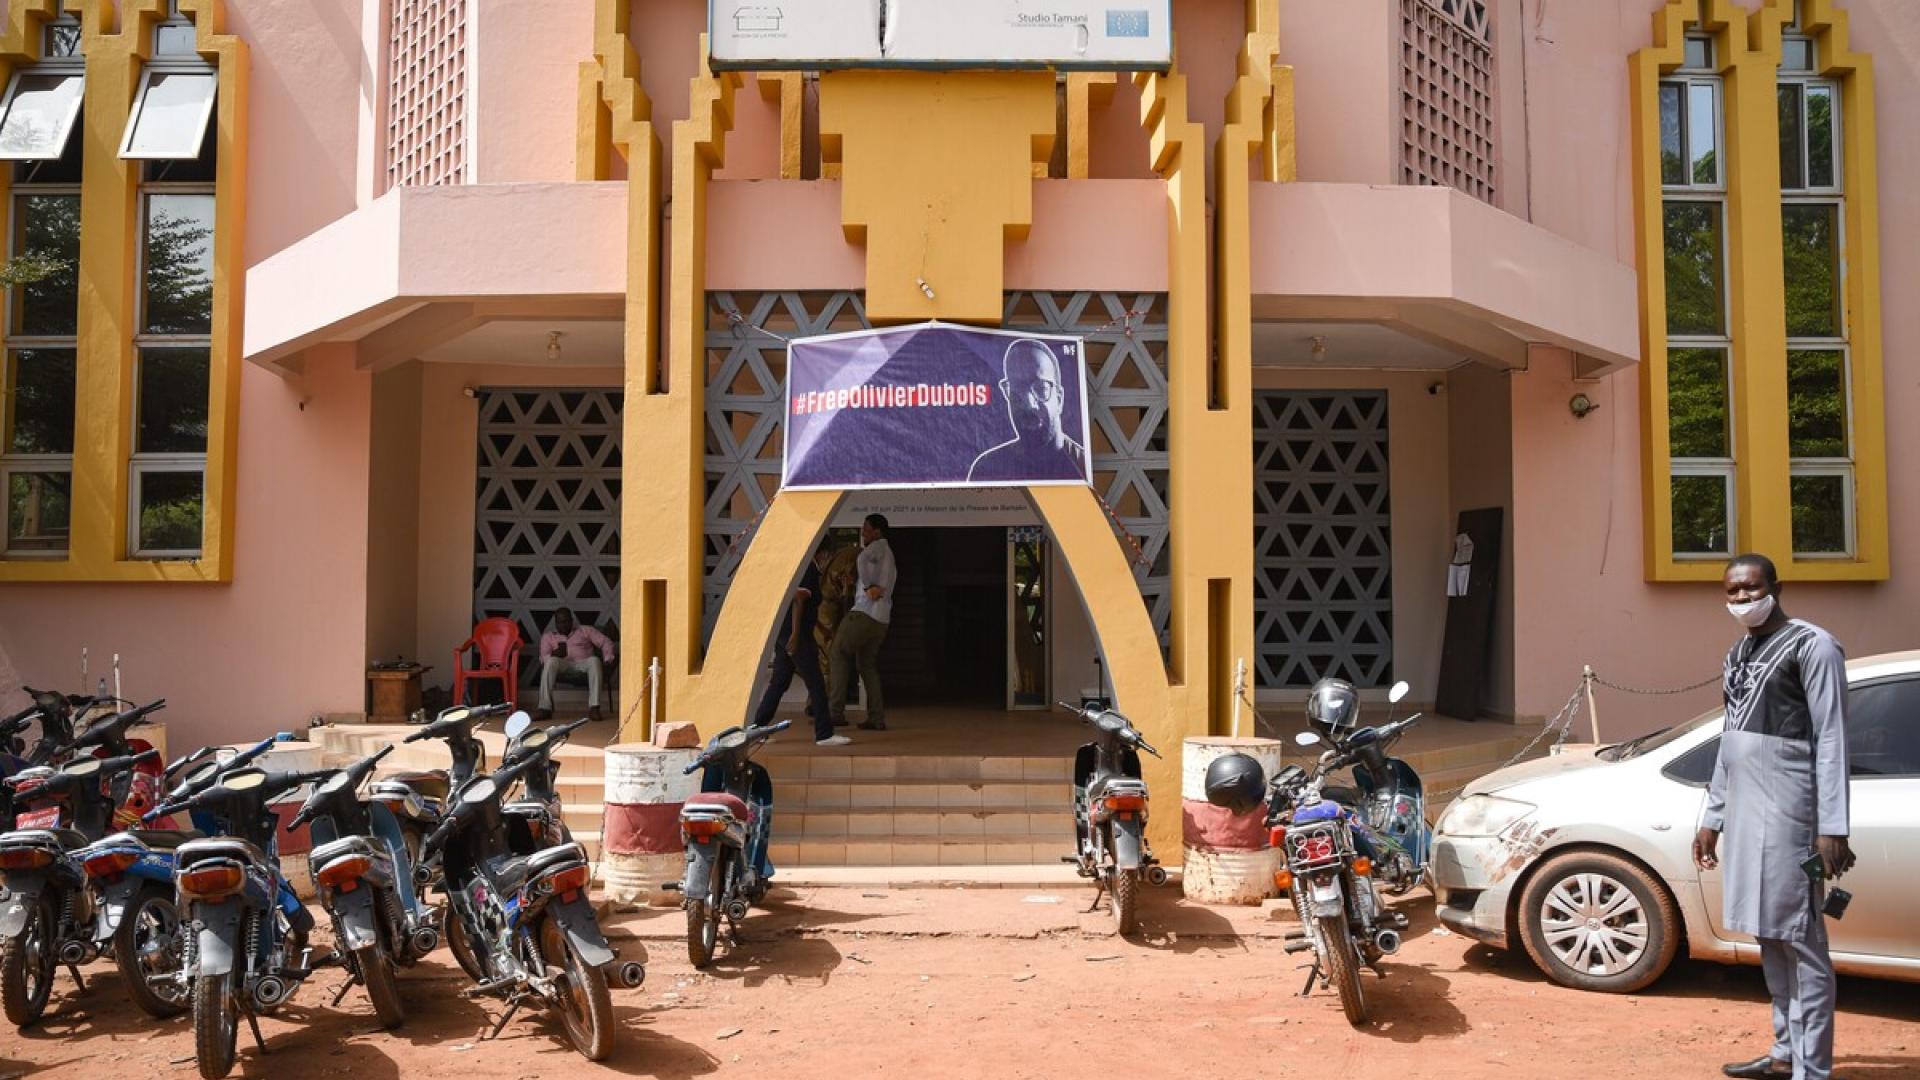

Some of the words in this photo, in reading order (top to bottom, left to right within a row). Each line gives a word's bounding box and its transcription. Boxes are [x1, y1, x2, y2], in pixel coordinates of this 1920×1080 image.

[1017, 12, 1050, 23] Studio
[1052, 13, 1089, 23] Tamani
[797, 382, 987, 415] #FreeOlivierDubois
